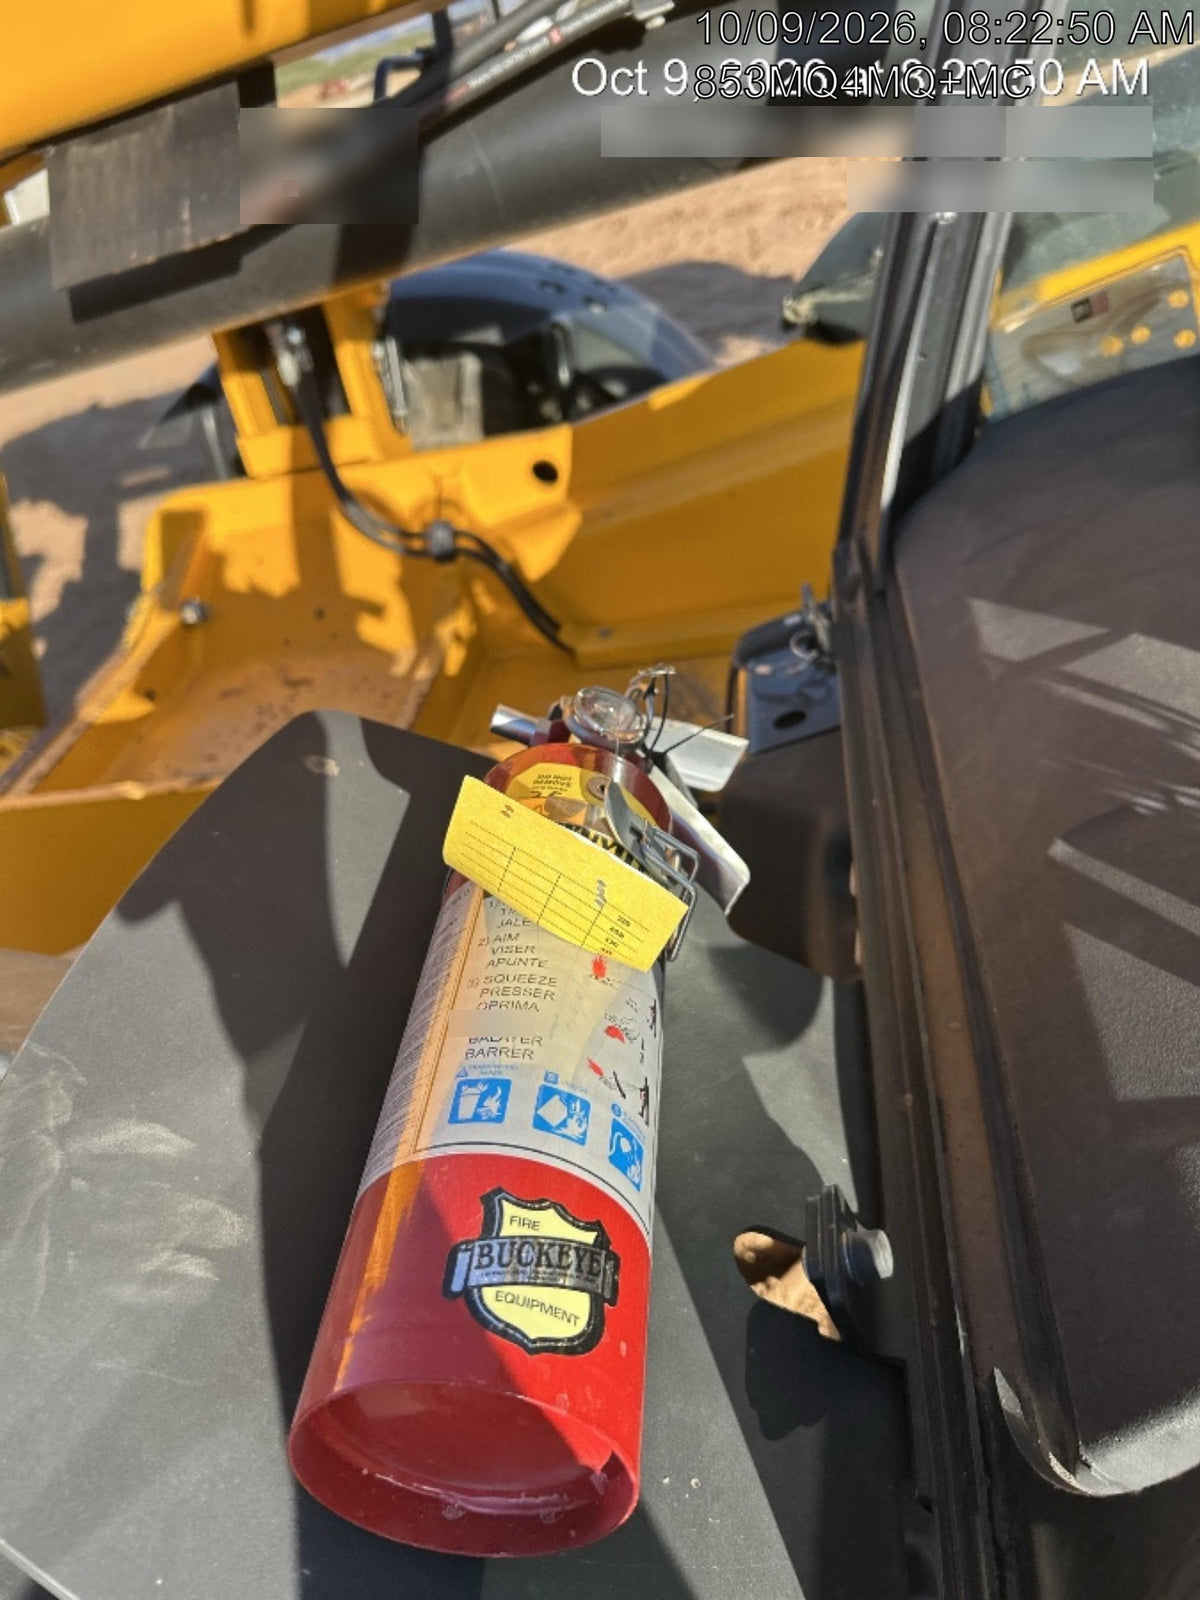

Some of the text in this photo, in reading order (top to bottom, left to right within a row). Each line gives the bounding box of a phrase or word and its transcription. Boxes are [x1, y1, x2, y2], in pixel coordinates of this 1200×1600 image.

[493, 932, 521, 943] AIM
[490, 945, 536, 955] VISER
[485, 957, 549, 969] APUNTE
[482, 973, 558, 987] SQUEEZE
[479, 986, 555, 1001] PRESSER
[476, 1000, 540, 1012] OPRIMA
[464, 1046, 535, 1061] BARRER
[508, 1215, 541, 1231] FIRE
[474, 1241, 601, 1276] BUCKEYE
[494, 1290, 581, 1327] EQUIPMENT
